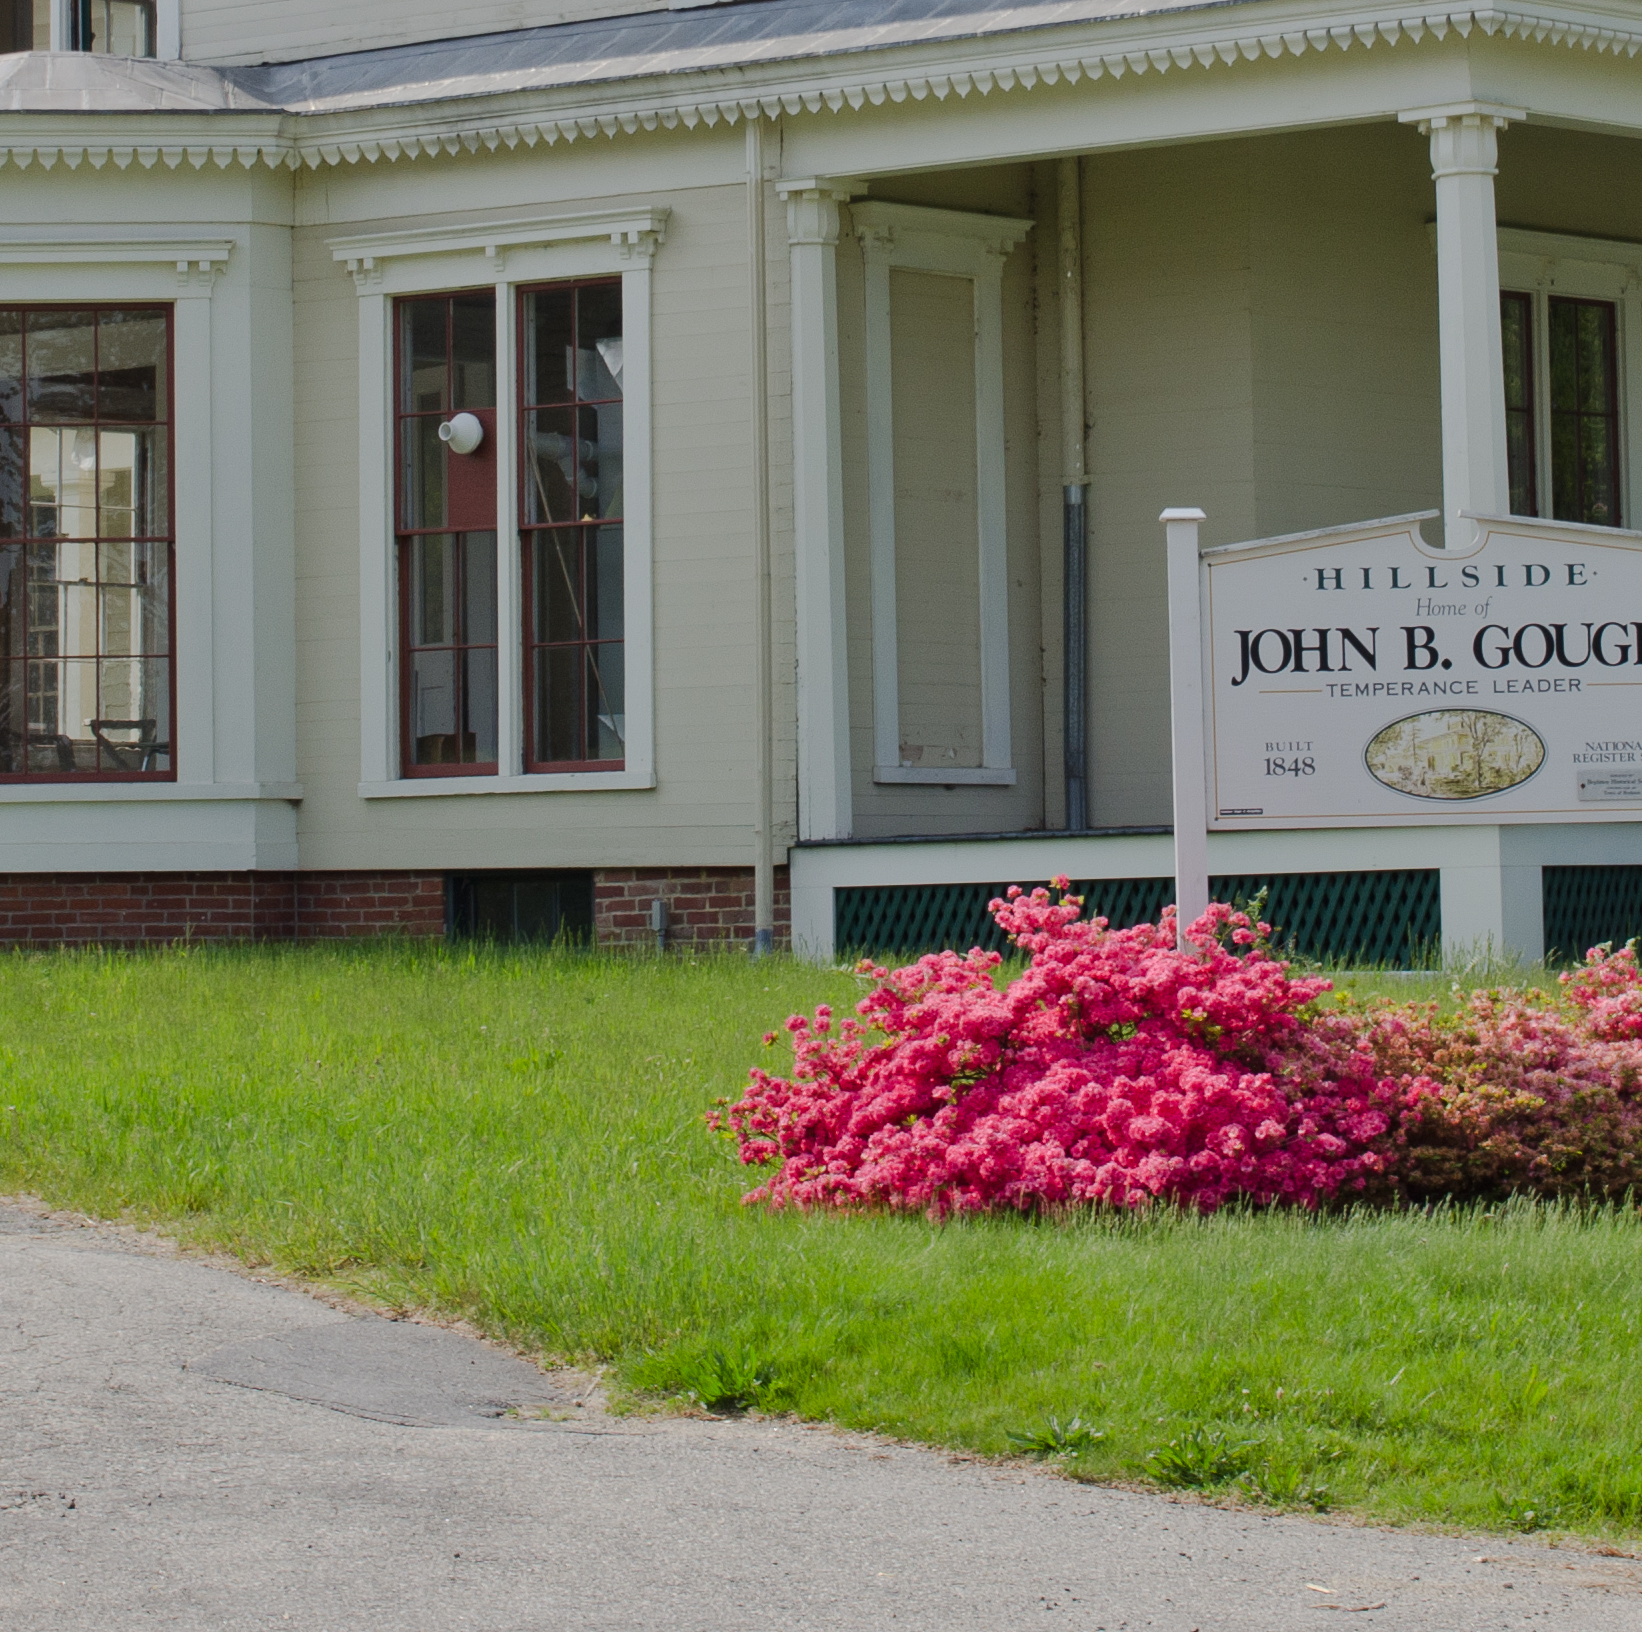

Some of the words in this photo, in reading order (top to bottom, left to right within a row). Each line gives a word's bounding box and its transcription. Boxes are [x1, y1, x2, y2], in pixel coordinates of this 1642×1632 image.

[1314, 563, 1588, 591] HILLSIDE
[1415, 597, 1467, 617] Home
[1474, 595, 1493, 619] of
[1230, 626, 1381, 687] JOHN
[1399, 625, 1453, 671] B.
[1325, 680, 1479, 698] TEMPERANCE
[1493, 678, 1582, 694] LEADER
[1265, 741, 1314, 752] BUILT
[1264, 756, 1316, 778] 1848
[1572, 752, 1636, 764] REGISTER
